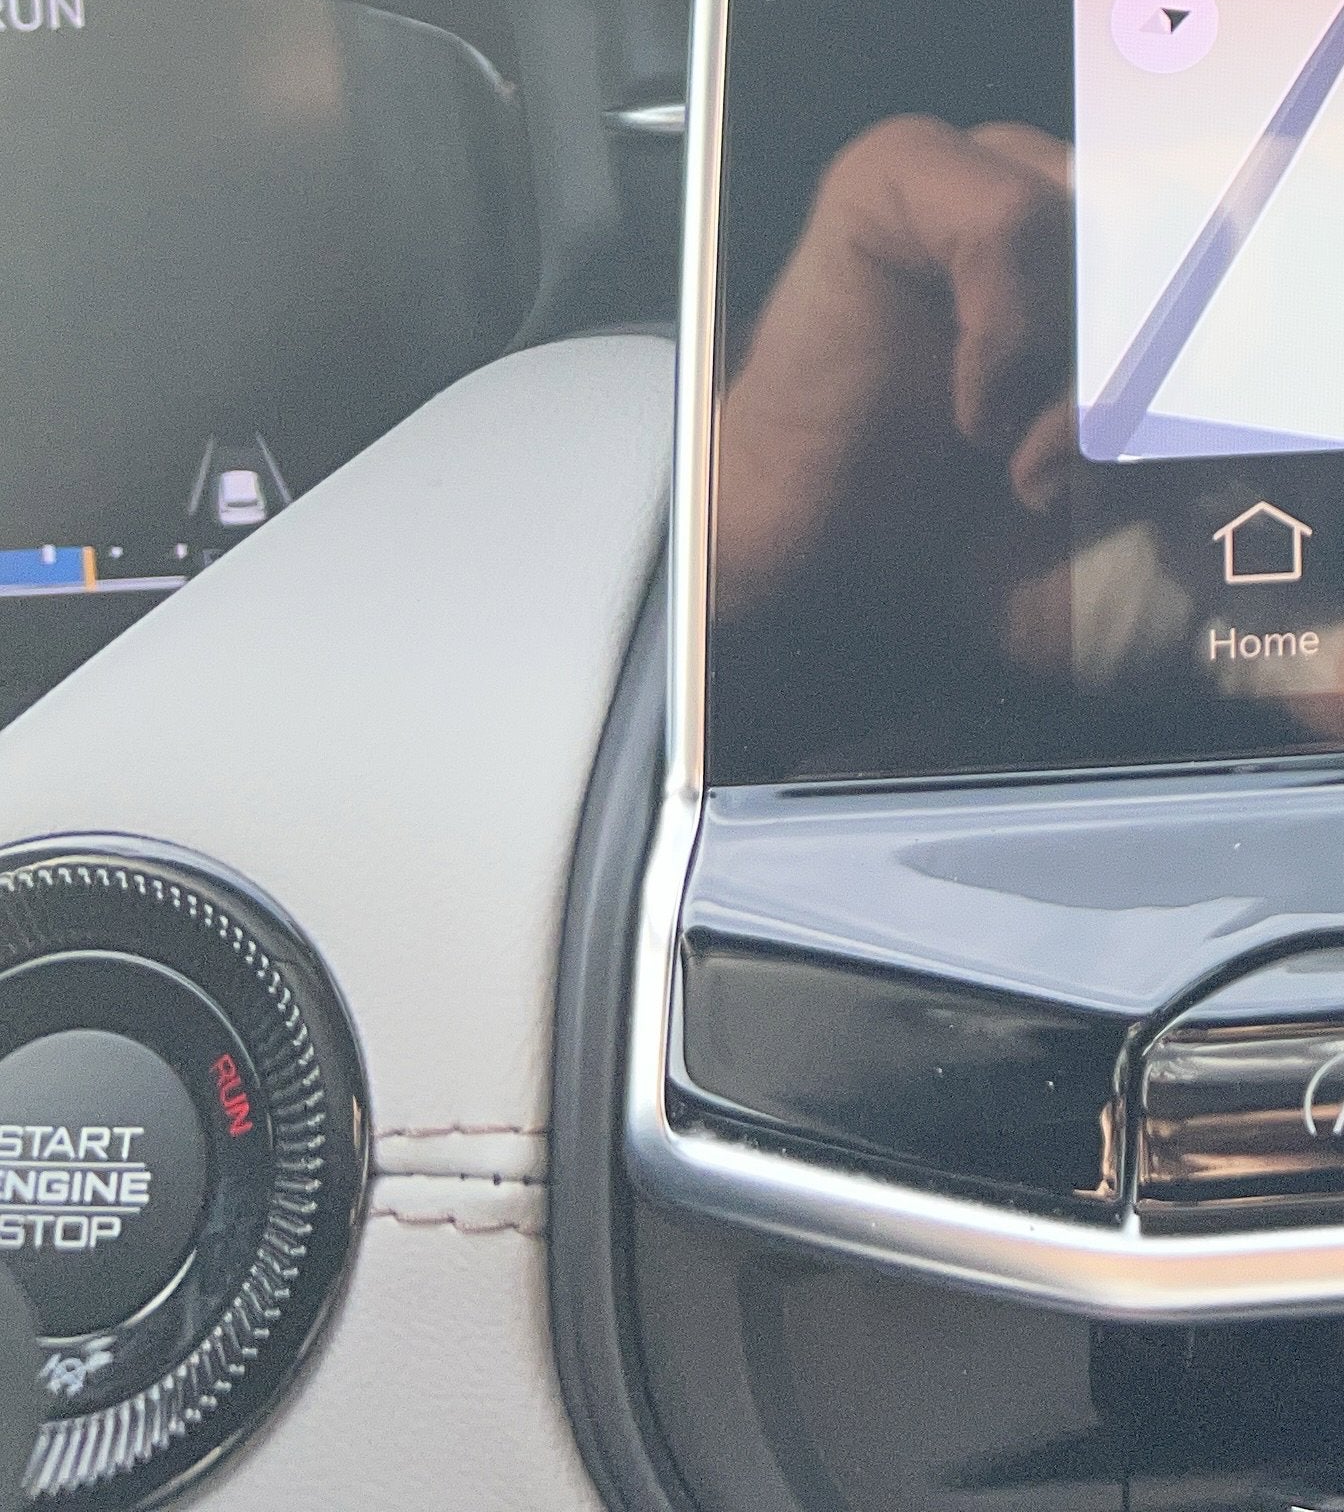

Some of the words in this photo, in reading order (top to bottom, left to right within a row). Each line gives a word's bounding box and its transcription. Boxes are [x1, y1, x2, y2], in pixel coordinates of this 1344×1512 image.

[1208, 622, 1321, 659] Home
[209, 1053, 254, 1137] RUN
[0, 1124, 145, 1160] START
[0, 1169, 152, 1205] NGINE
[0, 1214, 122, 1251] STOP
